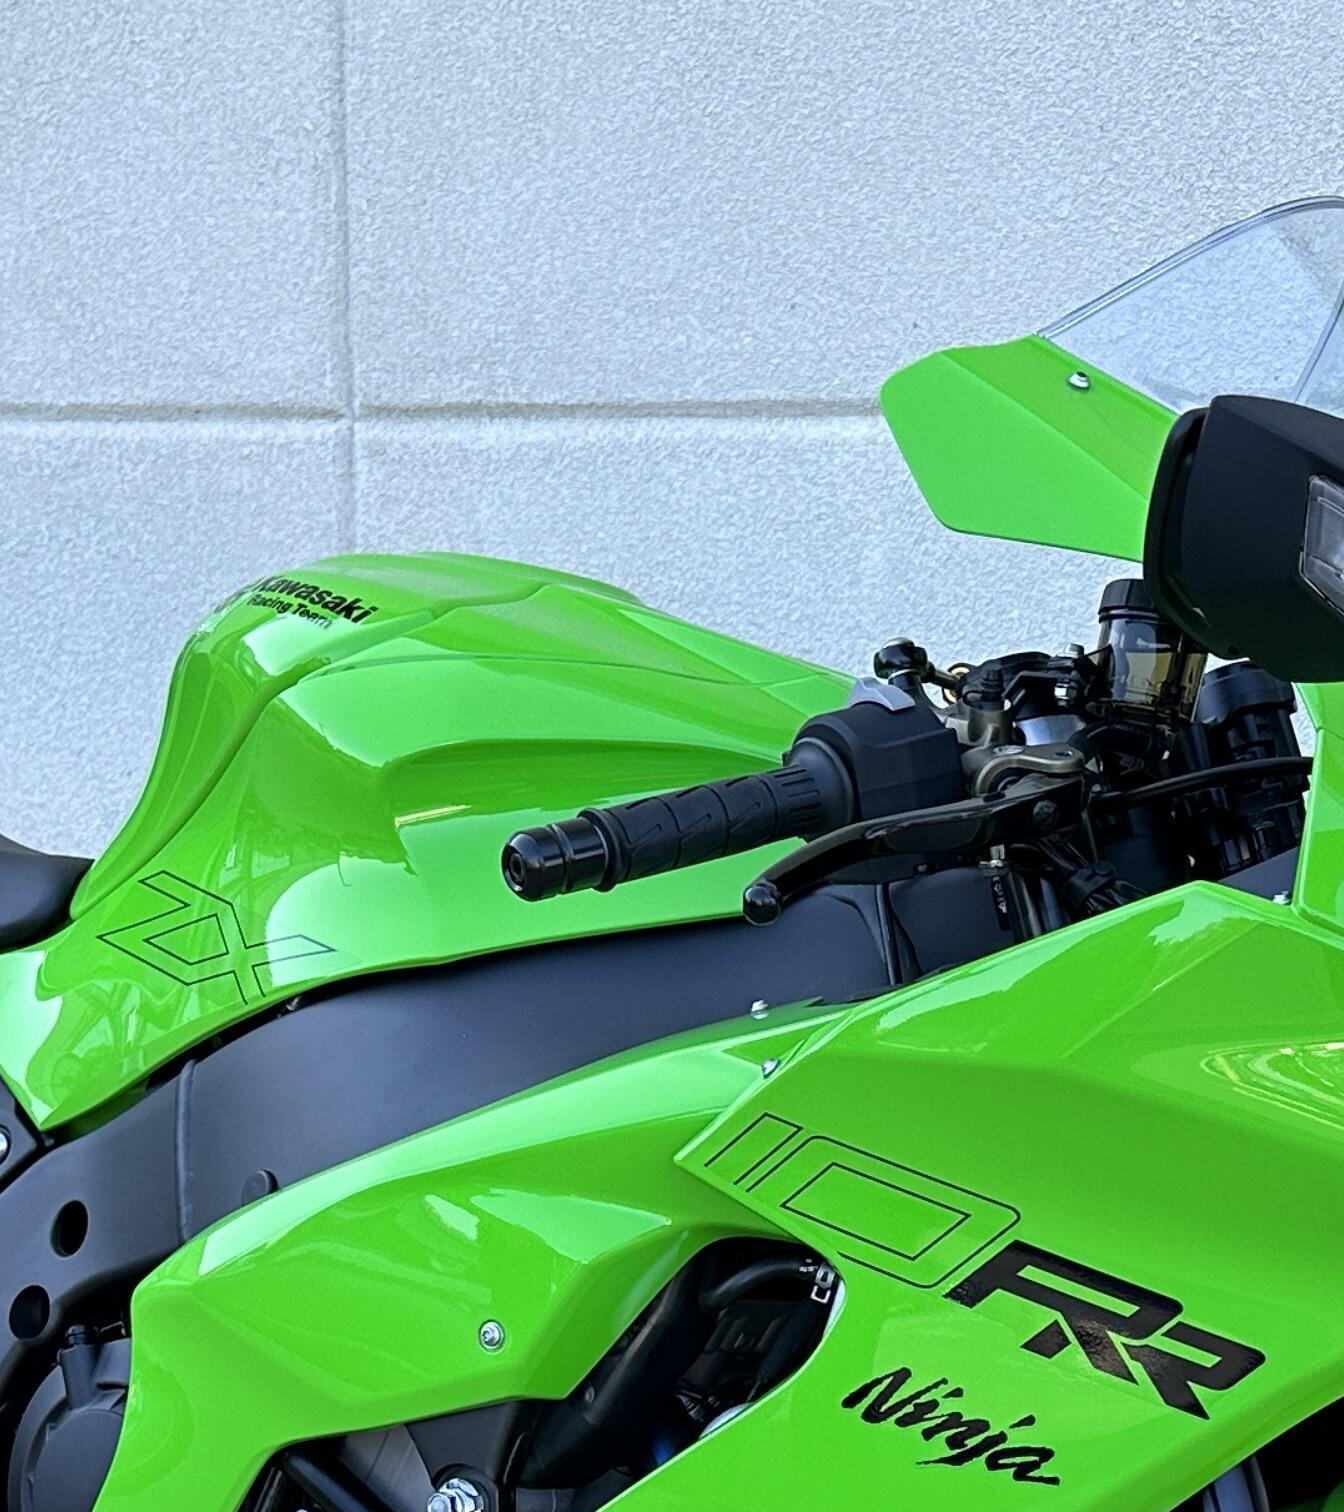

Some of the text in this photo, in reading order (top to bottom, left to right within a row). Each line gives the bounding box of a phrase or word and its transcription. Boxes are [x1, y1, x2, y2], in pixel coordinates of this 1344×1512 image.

[247, 594, 333, 630] Racing Team
[254, 575, 379, 623] Kawasaki
[841, 1366, 1060, 1486] Ninja
